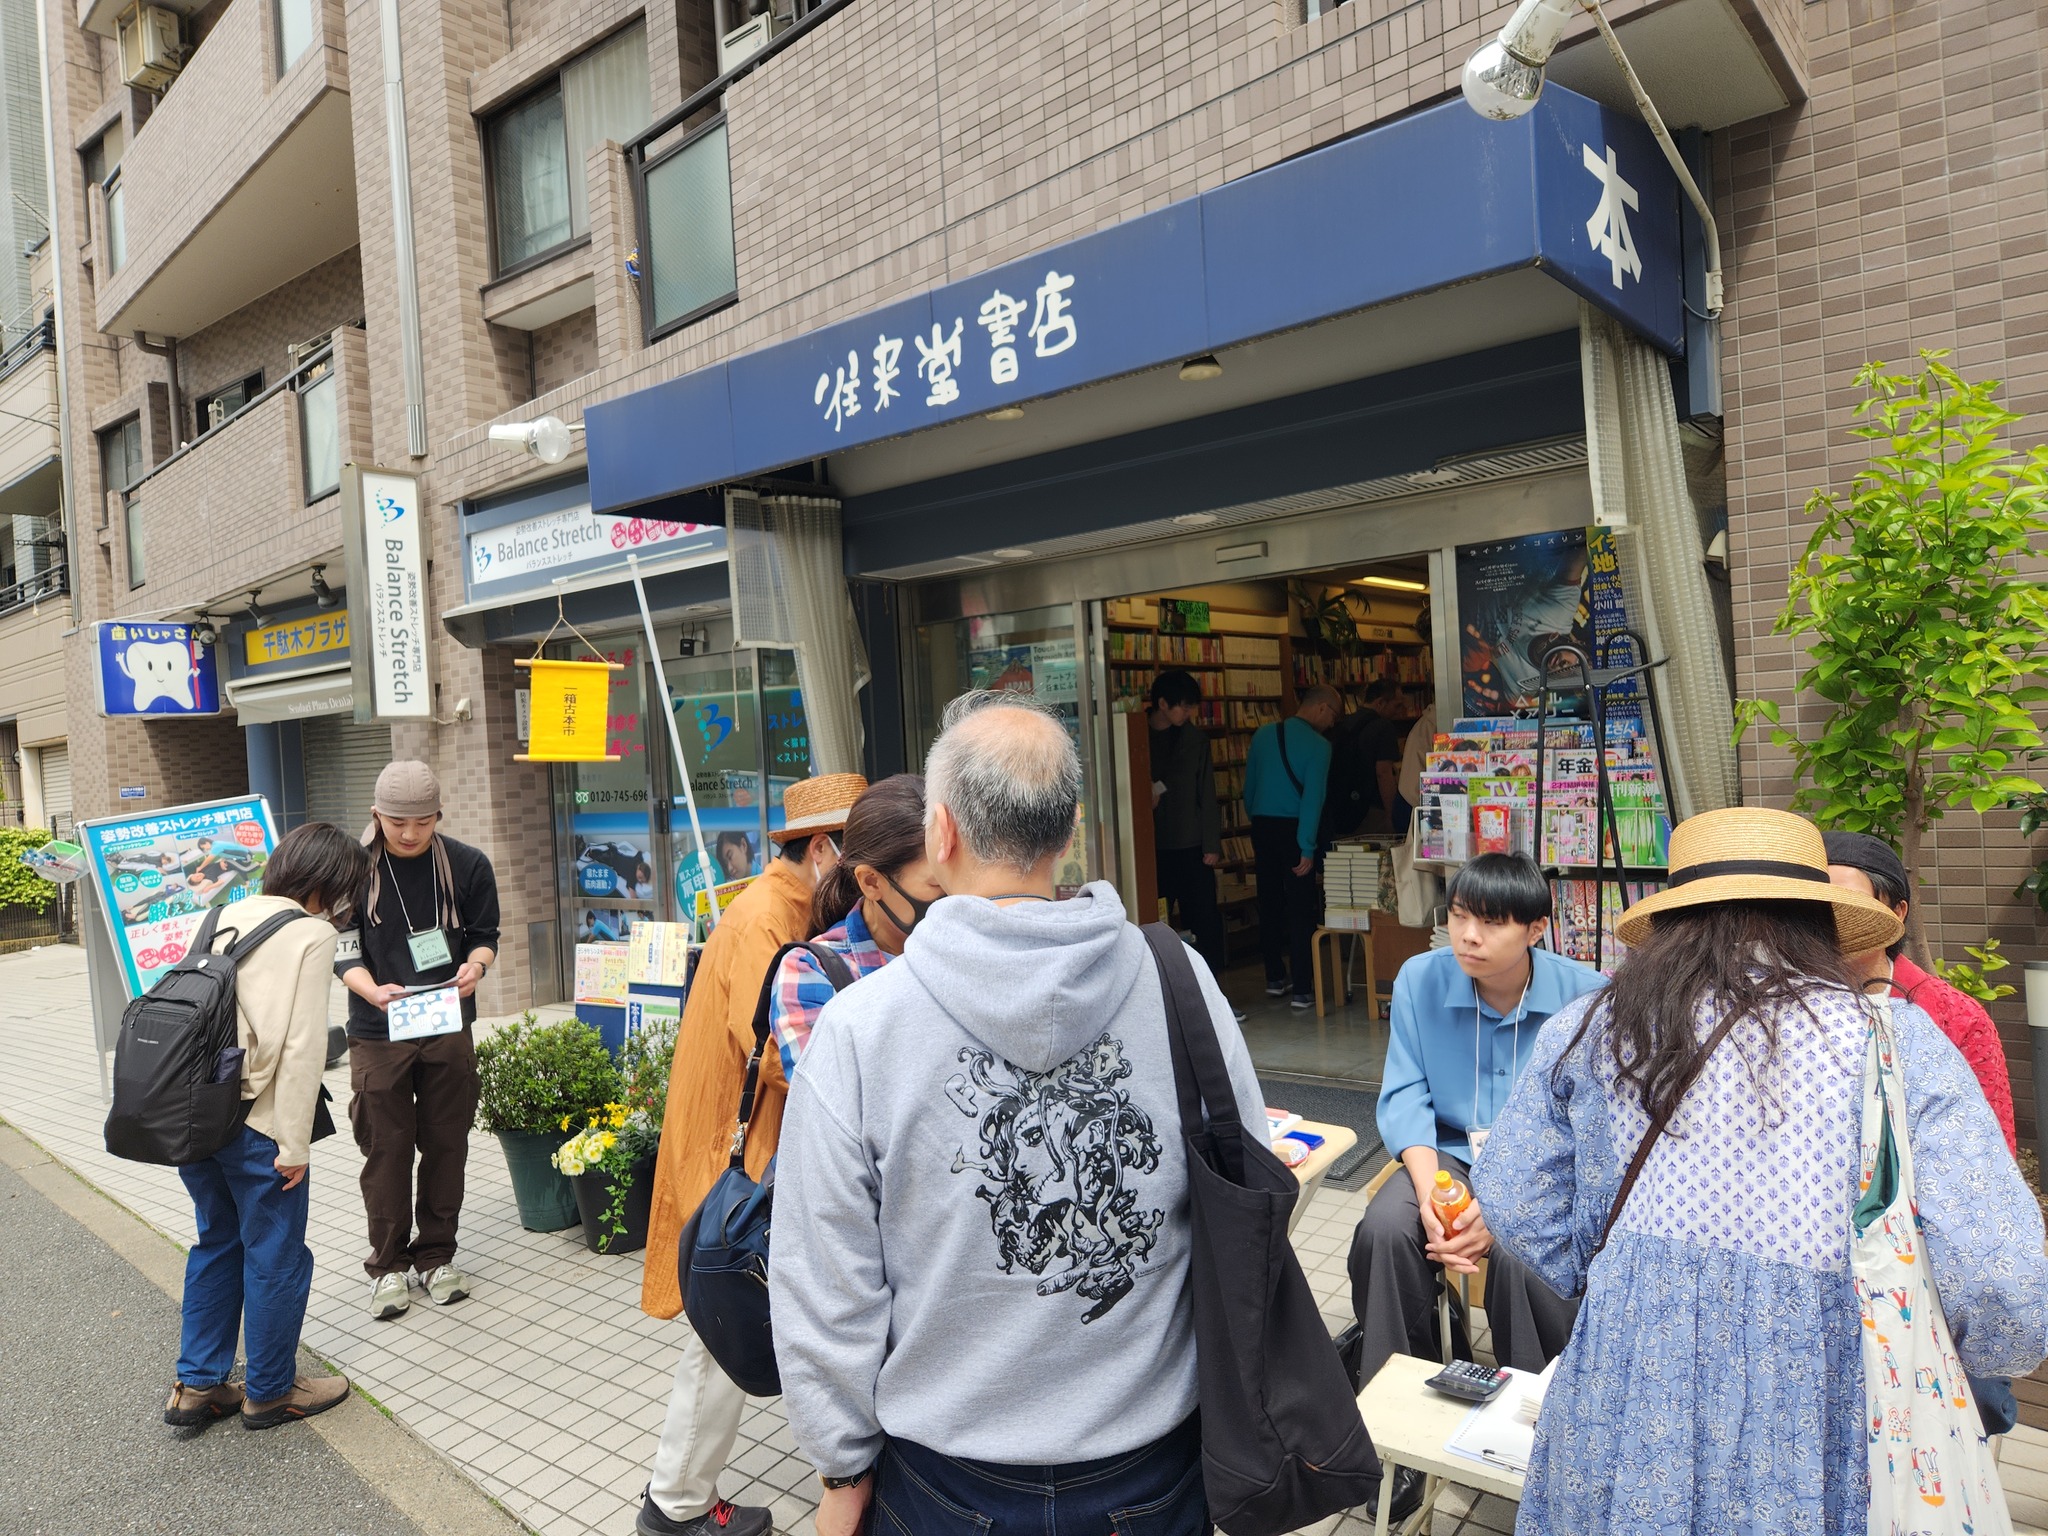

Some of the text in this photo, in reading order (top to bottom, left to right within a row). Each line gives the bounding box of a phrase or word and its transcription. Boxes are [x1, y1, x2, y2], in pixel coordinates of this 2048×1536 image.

[1582, 142, 1643, 290] 本
[497, 518, 603, 562] Balance Stretch
[263, 615, 346, 658] 千駄木プラザ
[375, 582, 388, 657] バランスストレッチ
[385, 538, 414, 704] Balance Stretch
[562, 687, 578, 737] 一箱古本市
[1576, 719, 1636, 738] サエさん
[690, 776, 753, 792] alance Stretch
[1557, 757, 1594, 774] 年金
[1484, 781, 1519, 797] TV
[1606, 782, 1656, 798] 刊新潮
[100, 807, 254, 844] 姿勢改善ストレッチ専門店
[130, 919, 180, 939] 正しく整え
